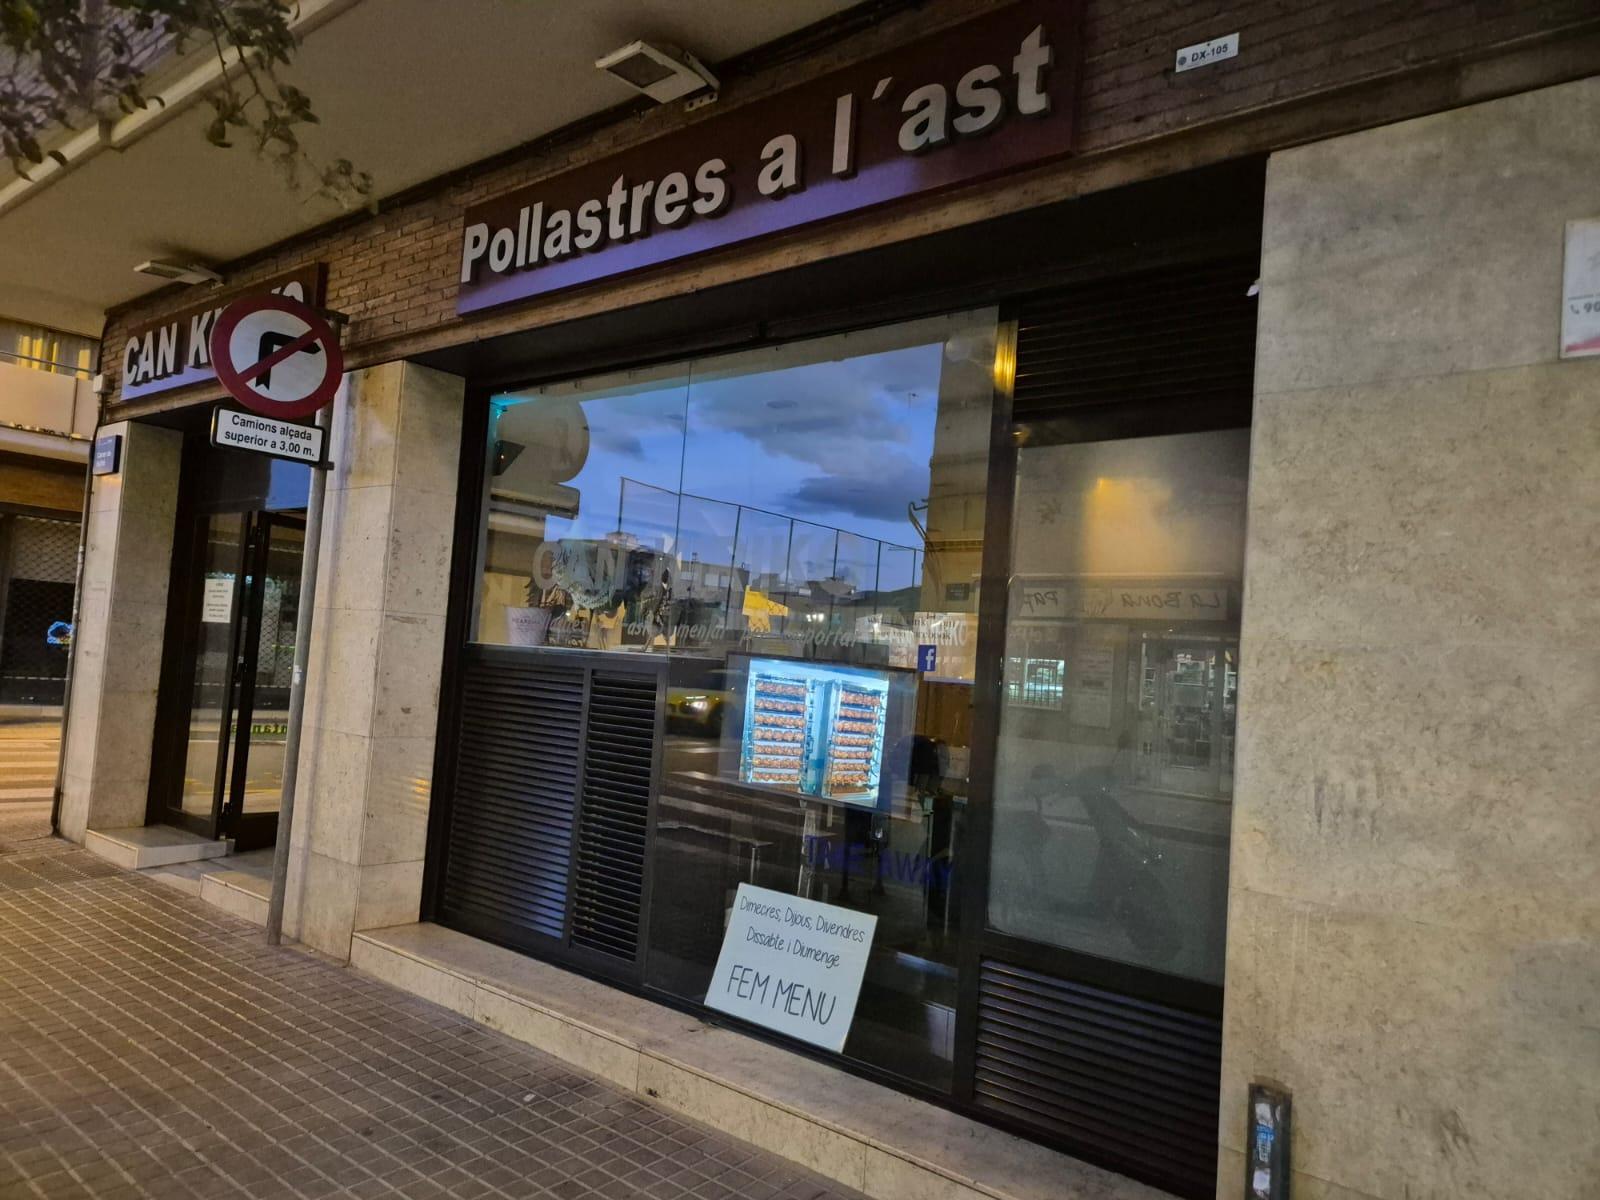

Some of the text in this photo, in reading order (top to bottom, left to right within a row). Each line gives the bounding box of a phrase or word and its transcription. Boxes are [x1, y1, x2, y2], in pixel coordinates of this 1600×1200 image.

[1191, 43, 1228, 62] DX-105
[461, 156, 727, 284] Pollastres
[755, 133, 800, 197] a
[123, 321, 178, 384] CAN
[224, 429, 315, 457] superior a 3,00 m.
[231, 414, 313, 442] Camions alçada
[740, 895, 782, 922] Dimecres,
[815, 914, 866, 944] Divendres
[746, 926, 840, 969] Dissabte i Diumenge
[727, 964, 837, 1026] FEM MENU
